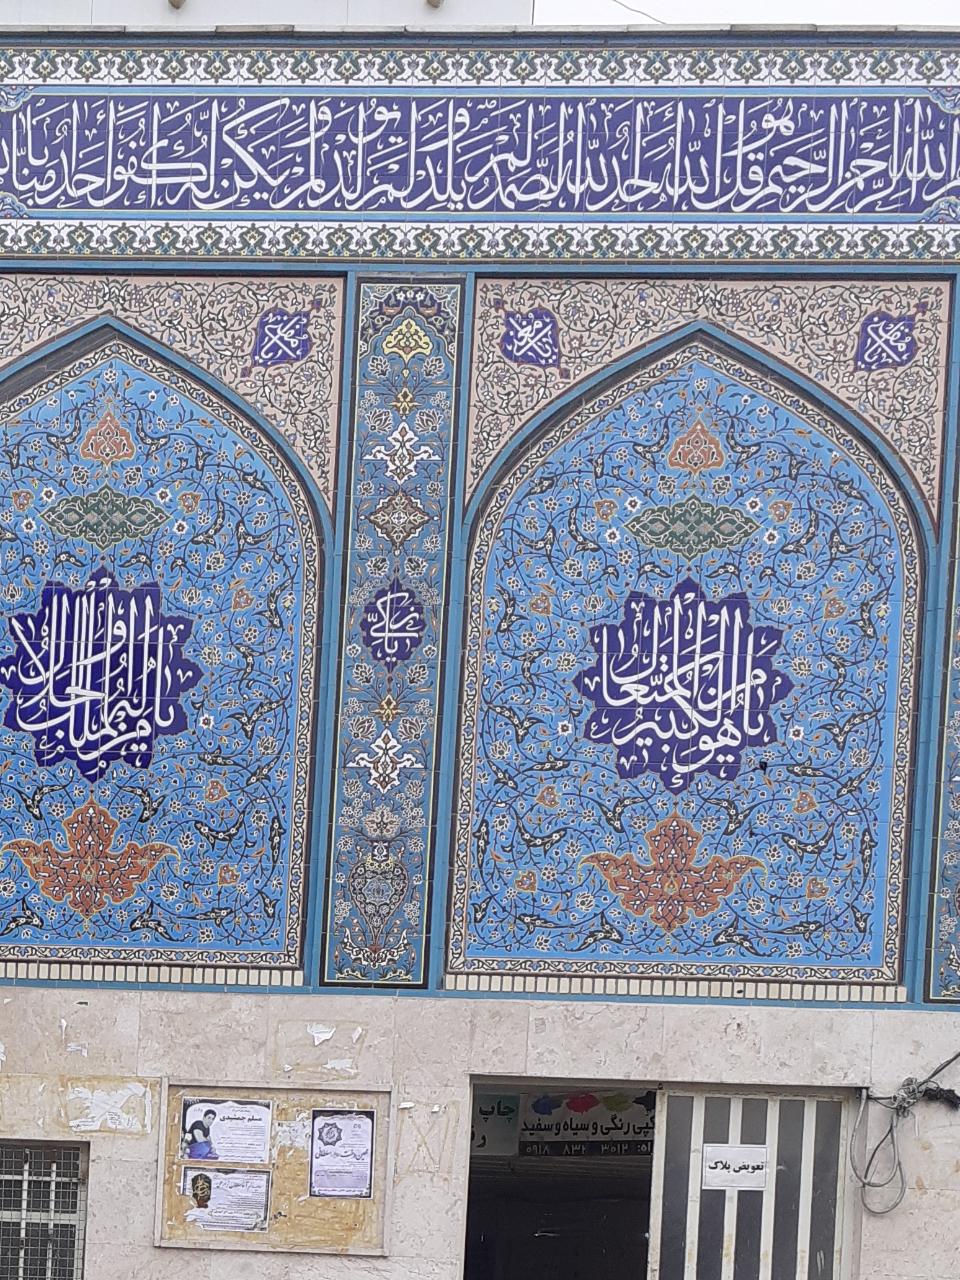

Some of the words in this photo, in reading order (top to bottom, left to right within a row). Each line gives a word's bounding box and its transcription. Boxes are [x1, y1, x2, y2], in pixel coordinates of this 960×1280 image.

[479, 1100, 515, 1123] چاپ
[522, 1118, 554, 1136] سفید
[563, 1117, 589, 1135] سیاه
[601, 1113, 629, 1135] رنگی
[732, 1162, 764, 1173] تعویض
